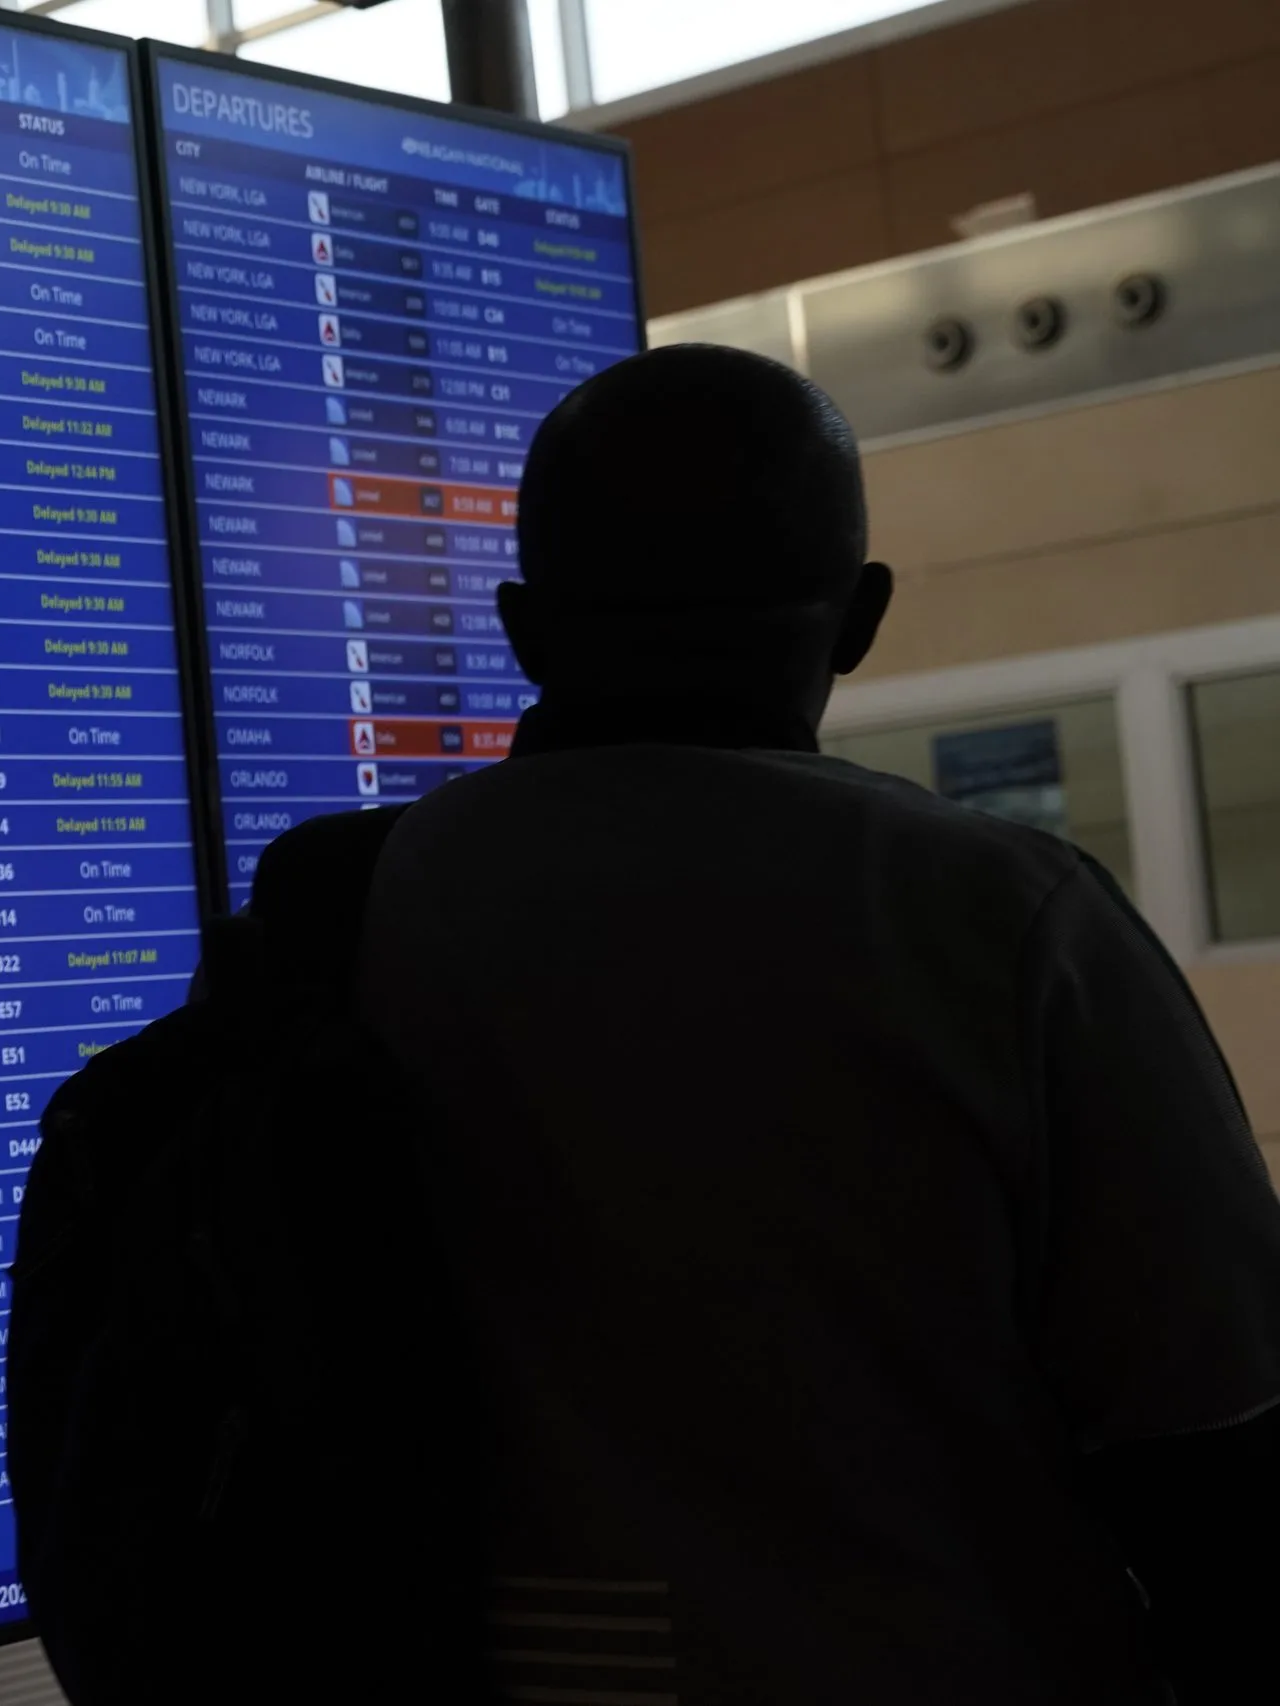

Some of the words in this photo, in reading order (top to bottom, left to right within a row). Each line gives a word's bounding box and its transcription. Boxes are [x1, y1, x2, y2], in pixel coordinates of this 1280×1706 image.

[172, 83, 313, 138] DEPARTURES
[18, 113, 65, 136] STATUS
[19, 150, 39, 168] On
[41, 154, 71, 175] Time
[79, 861, 100, 879] On
[101, 860, 132, 878] Time
[4, 1091, 31, 1112] E52
